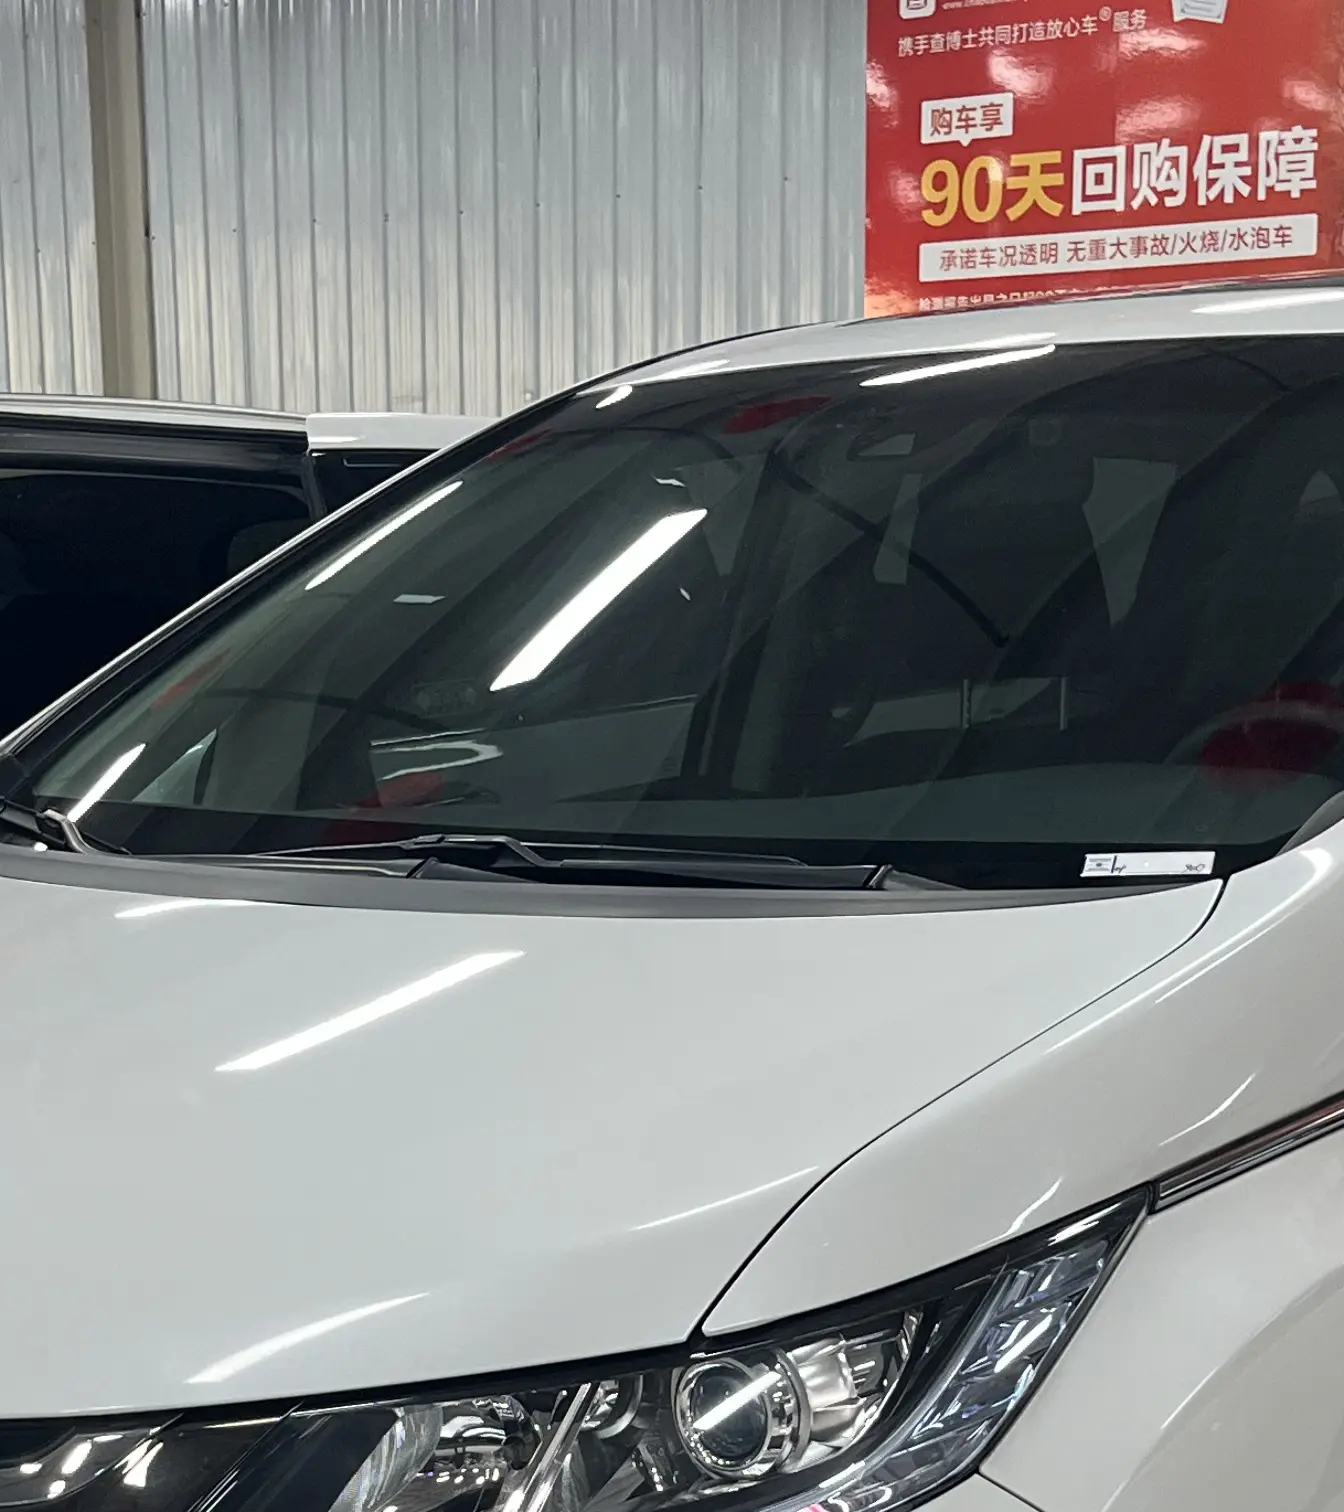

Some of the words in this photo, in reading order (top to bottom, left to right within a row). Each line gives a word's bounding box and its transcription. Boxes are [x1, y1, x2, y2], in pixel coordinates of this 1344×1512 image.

[930, 102, 1004, 137] 购车享
[939, 241, 1059, 272] 承诺车况透明
[1066, 225, 1293, 263] 无重大事故/火烧/水泡车
